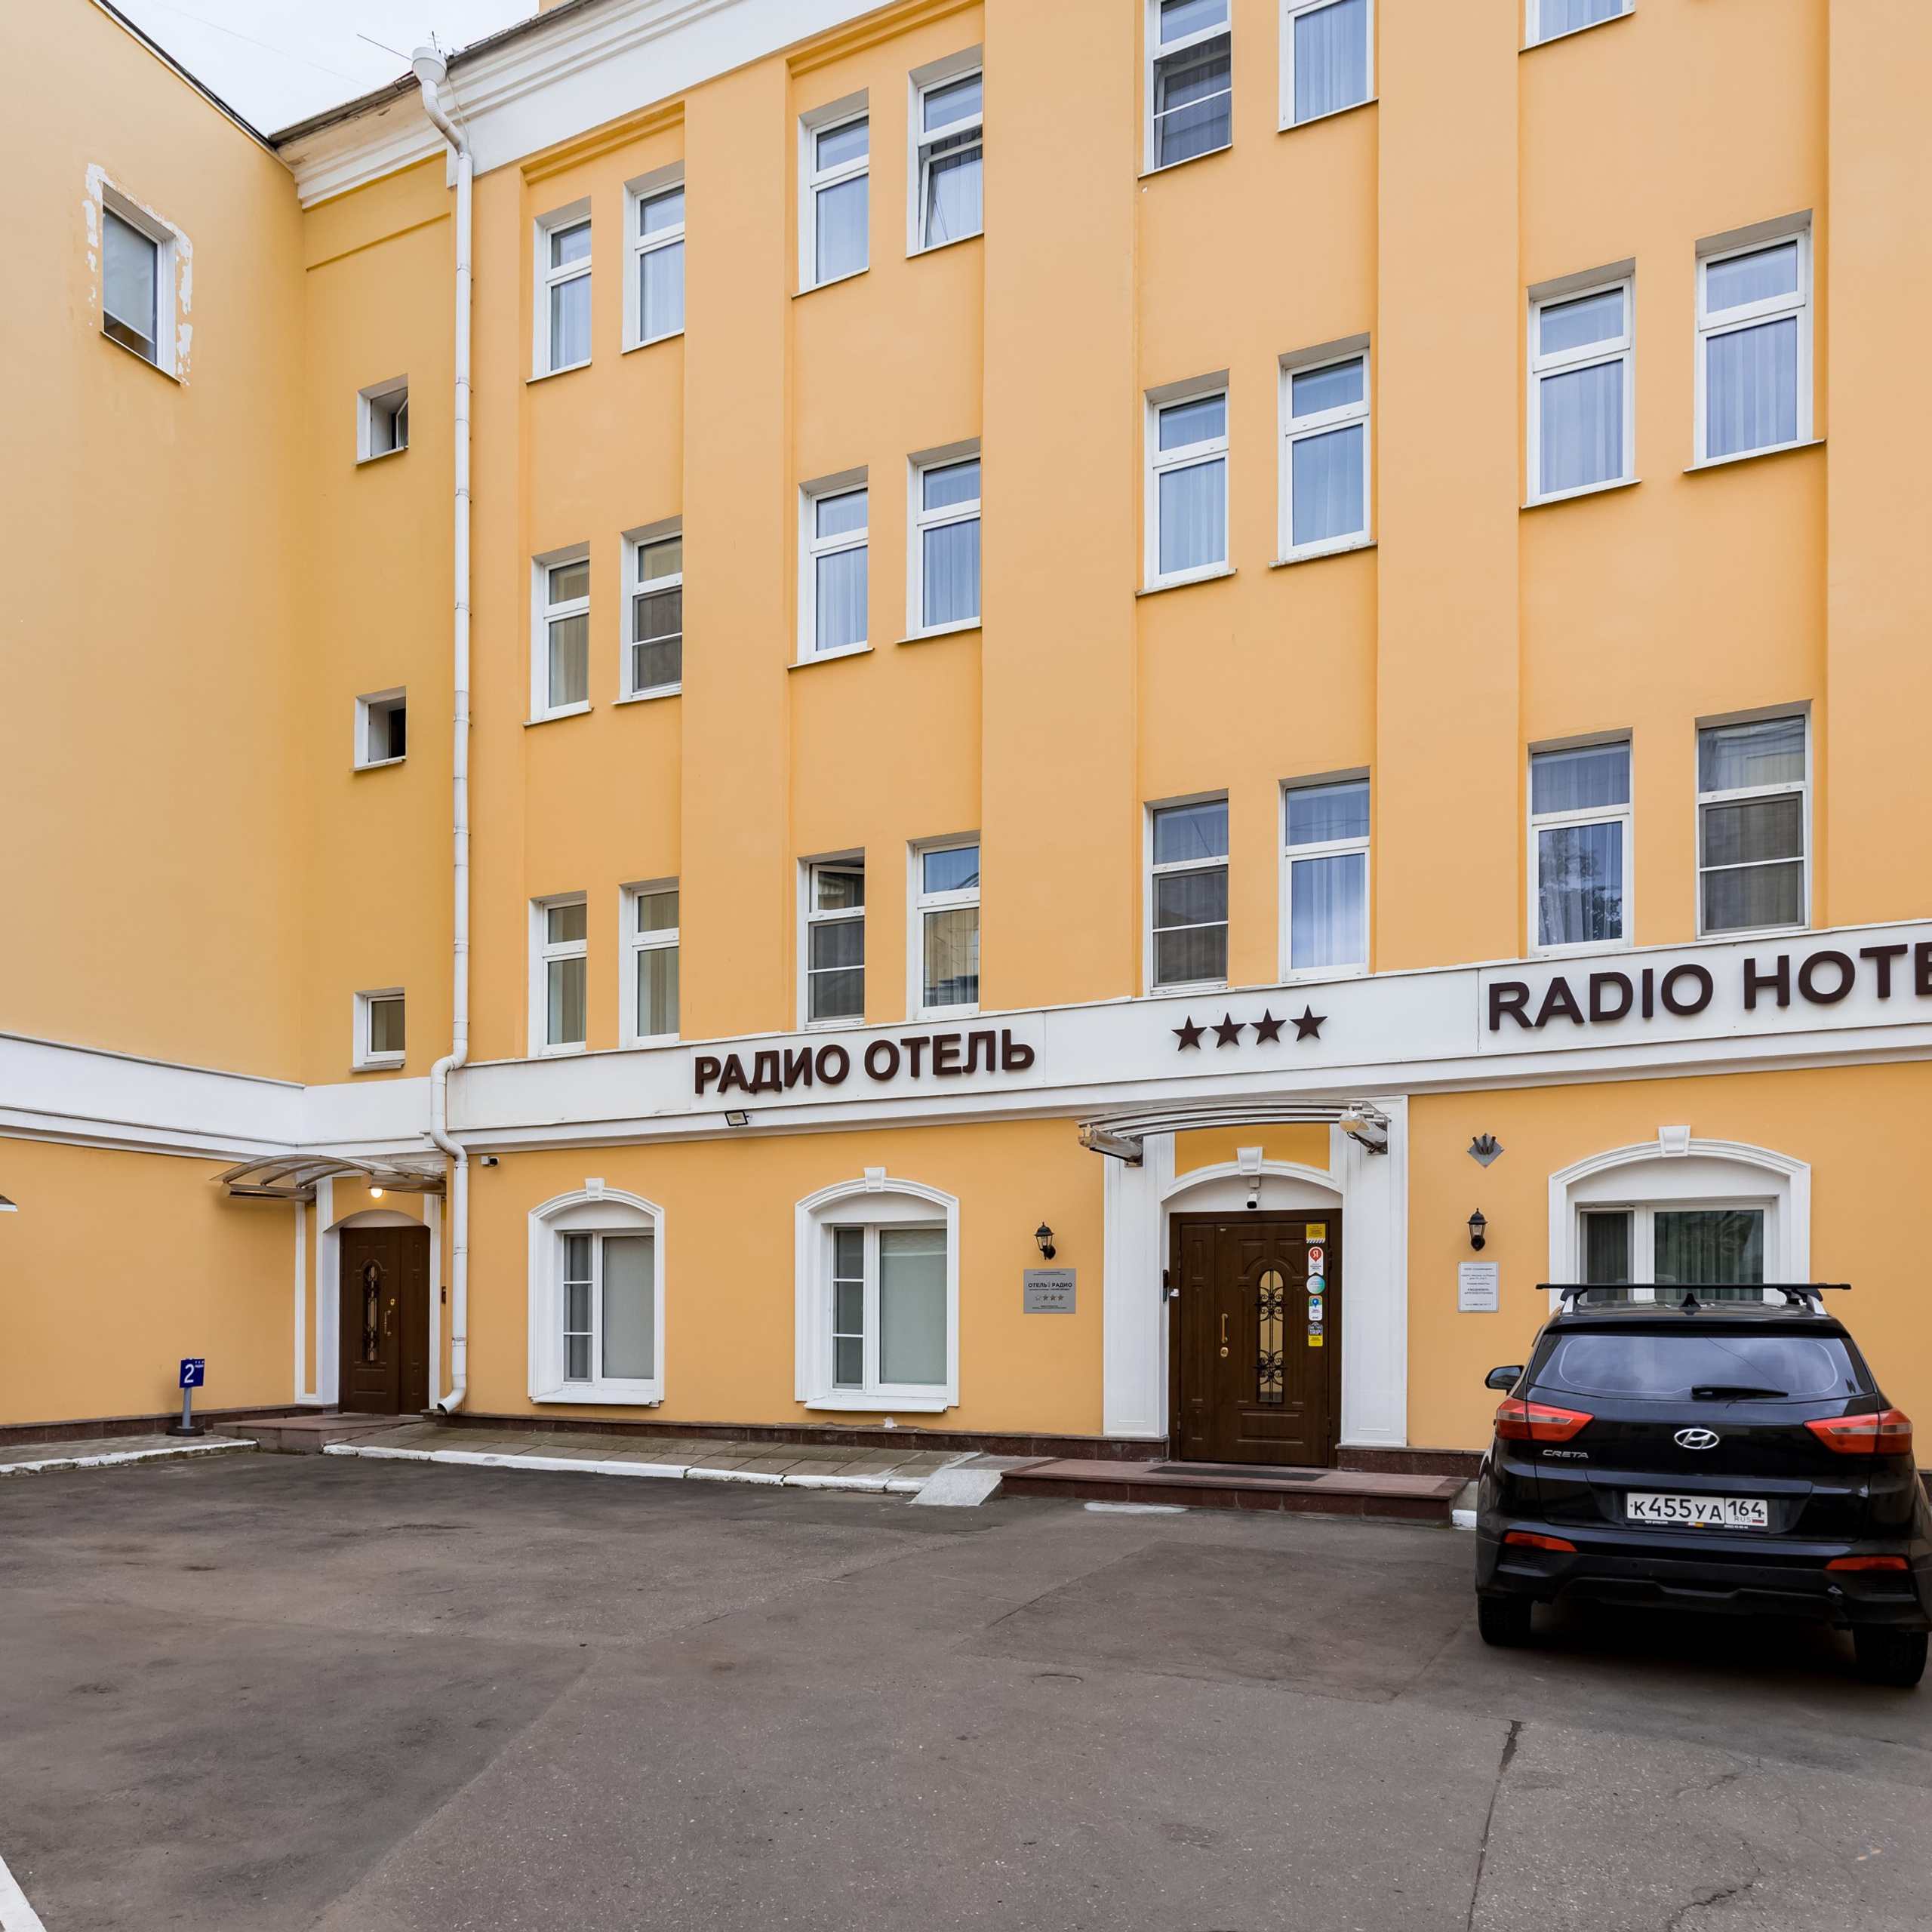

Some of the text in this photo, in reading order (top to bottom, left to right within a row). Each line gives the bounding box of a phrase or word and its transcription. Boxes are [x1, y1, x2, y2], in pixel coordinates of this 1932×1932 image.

[1489, 963, 1714, 1031] RADIO
[694, 1029, 1035, 1094] РАДИО ОТЕЛЬ
[1312, 1249, 1319, 1258] Я
[184, 1364, 195, 1383] 2
[1542, 1449, 1589, 1459] CRETA
[1634, 1497, 1762, 1521] К455УА 164
